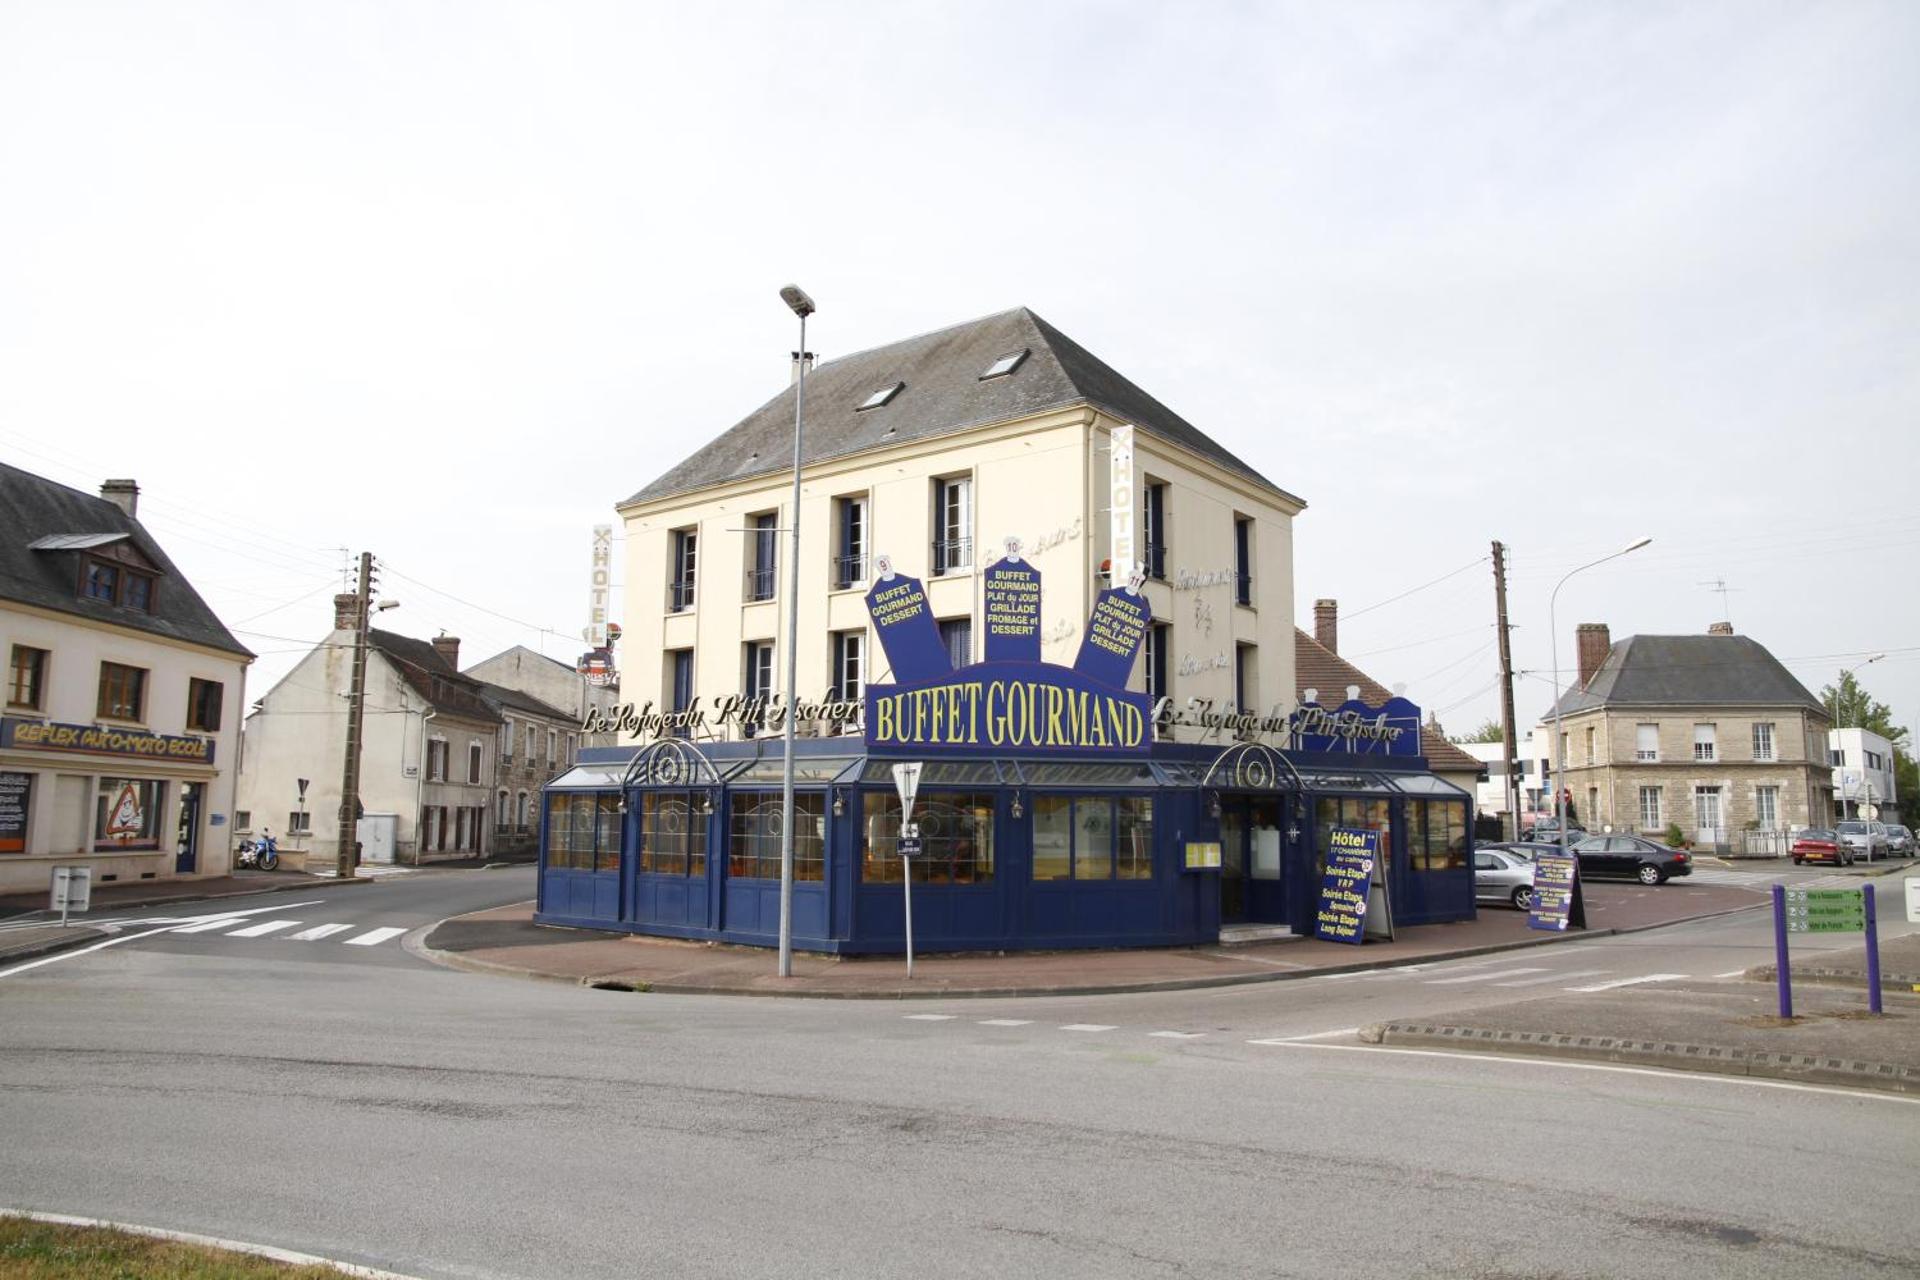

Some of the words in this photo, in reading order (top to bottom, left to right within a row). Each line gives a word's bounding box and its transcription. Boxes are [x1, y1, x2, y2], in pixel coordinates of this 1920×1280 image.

[1113, 460, 1131, 584] HOTEL
[1007, 542, 1018, 553] 10
[987, 580, 1039, 592] GOURMAND
[994, 570, 1031, 581] BUFFET
[591, 553, 608, 643] HOTEL
[875, 583, 911, 603] BUFFET
[987, 591, 1006, 601] PLAT
[1006, 592, 1017, 602] du
[1018, 594, 1039, 603] JOUR
[872, 592, 924, 617] GOURMAND
[880, 603, 923, 626] DESSERT
[990, 602, 1037, 614] GRILLADE
[1097, 602, 1145, 628] GOURMAND
[1107, 595, 1142, 616] BUFFET
[987, 613, 1029, 625] FROMAGE
[1030, 616, 1038, 625] et
[992, 624, 1036, 635] DESSERT
[1094, 612, 1113, 626] PLAT
[1111, 620, 1121, 630] du
[1122, 625, 1142, 639] JOUR
[1090, 634, 1131, 657] DESSERT
[1092, 623, 1137, 649] GRILLADE
[581, 705, 608, 733] Le
[608, 700, 674, 739] Refuge
[673, 696, 705, 730] du
[875, 682, 984, 743] BUFFET
[986, 680, 1144, 747] GOURMAND
[1150, 696, 1185, 725] Le
[1187, 696, 1260, 739] Refuge
[1263, 703, 1286, 733] du
[1341, 710, 1404, 742] Fischer
[14, 723, 79, 745] REFLEX
[80, 726, 167, 753] AUTO-MOTO
[168, 741, 208, 757] ECOLE
[1331, 831, 1365, 847] Hôtel
[1325, 865, 1346, 877] Soirée
[1347, 867, 1367, 879] Etape
[1322, 888, 1342, 900] Soirée
